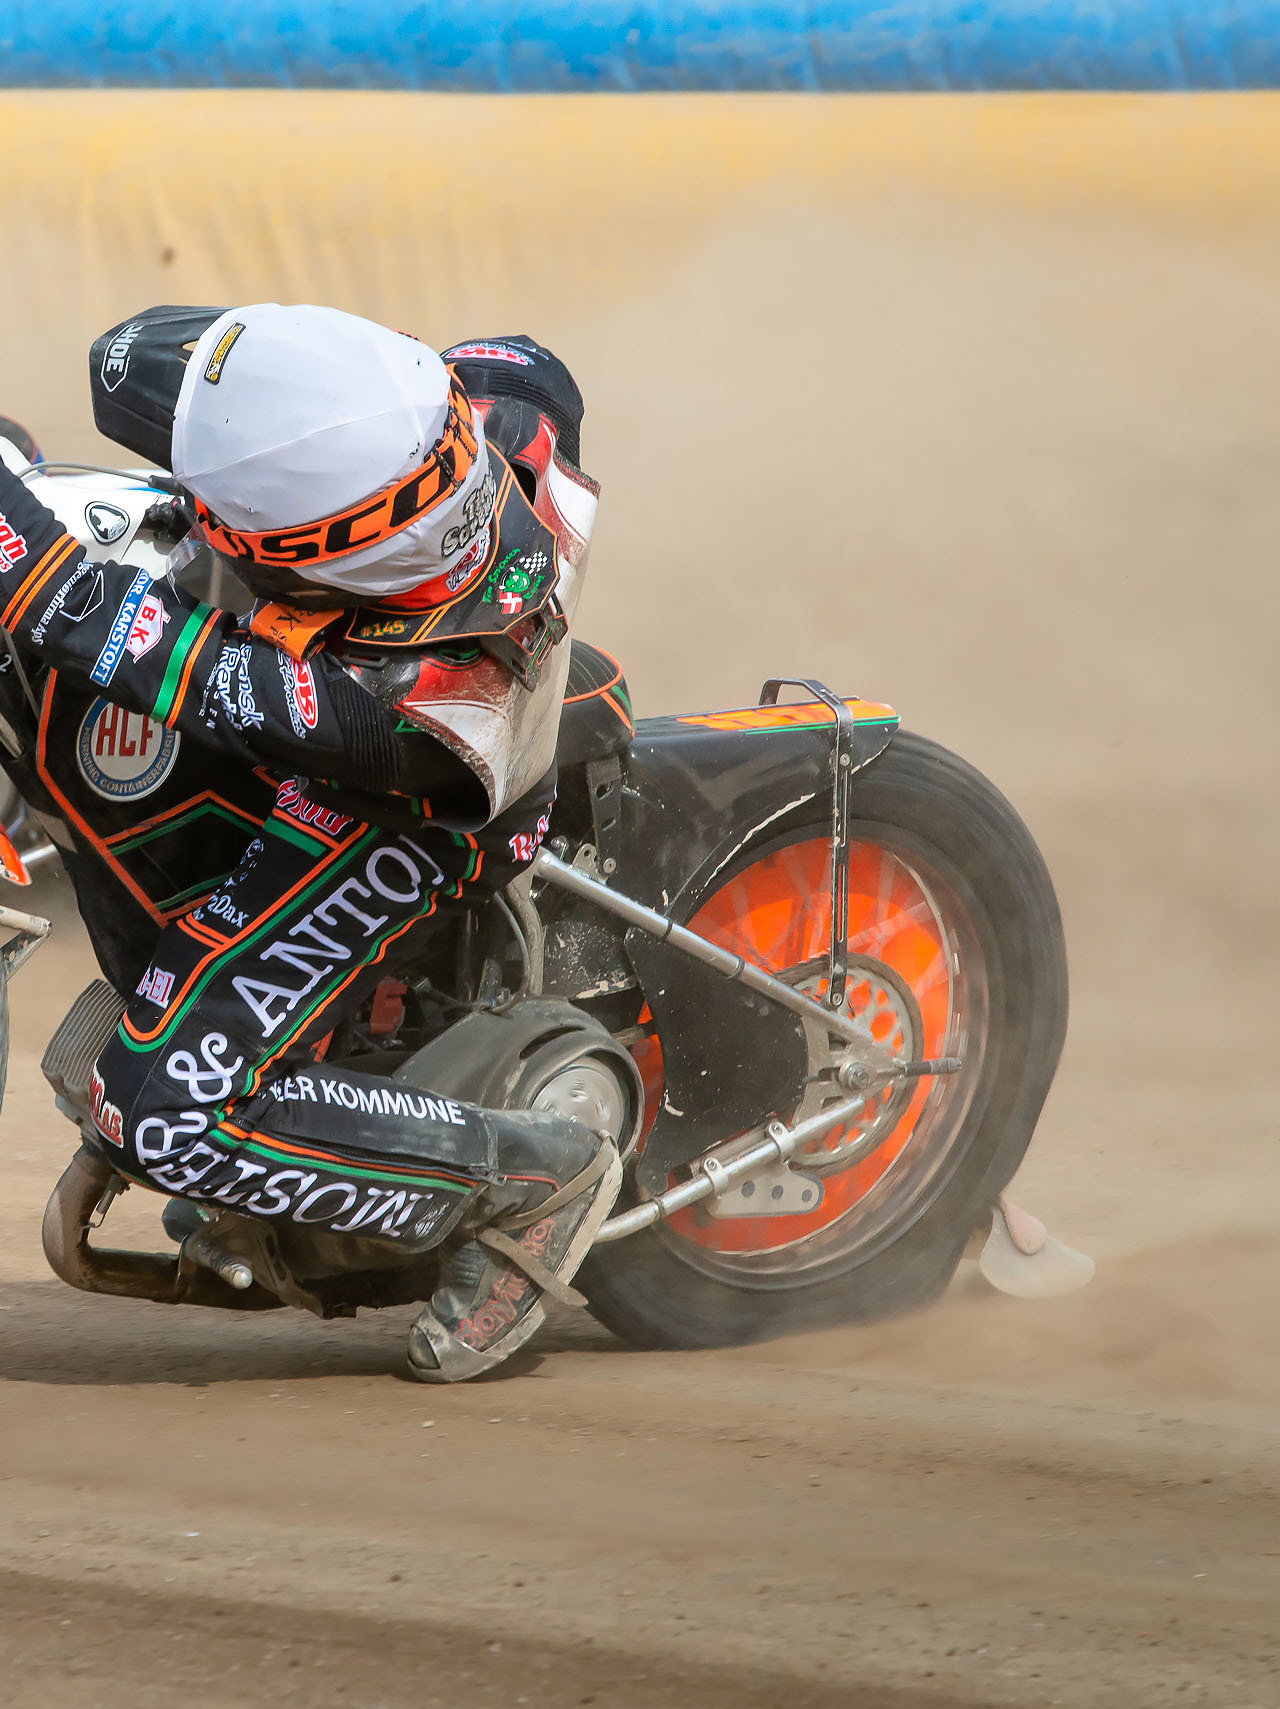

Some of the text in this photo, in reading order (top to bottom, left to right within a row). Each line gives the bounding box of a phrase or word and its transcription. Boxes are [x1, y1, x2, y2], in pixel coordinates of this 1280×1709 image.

[32, 622, 50, 647] ApS
[93, 601, 135, 683] KARSTOFT
[129, 605, 160, 651] B.K.
[361, 620, 406, 638] #145
[166, 1031, 244, 1104] &
[320, 1078, 467, 1127] KOMMUNE
